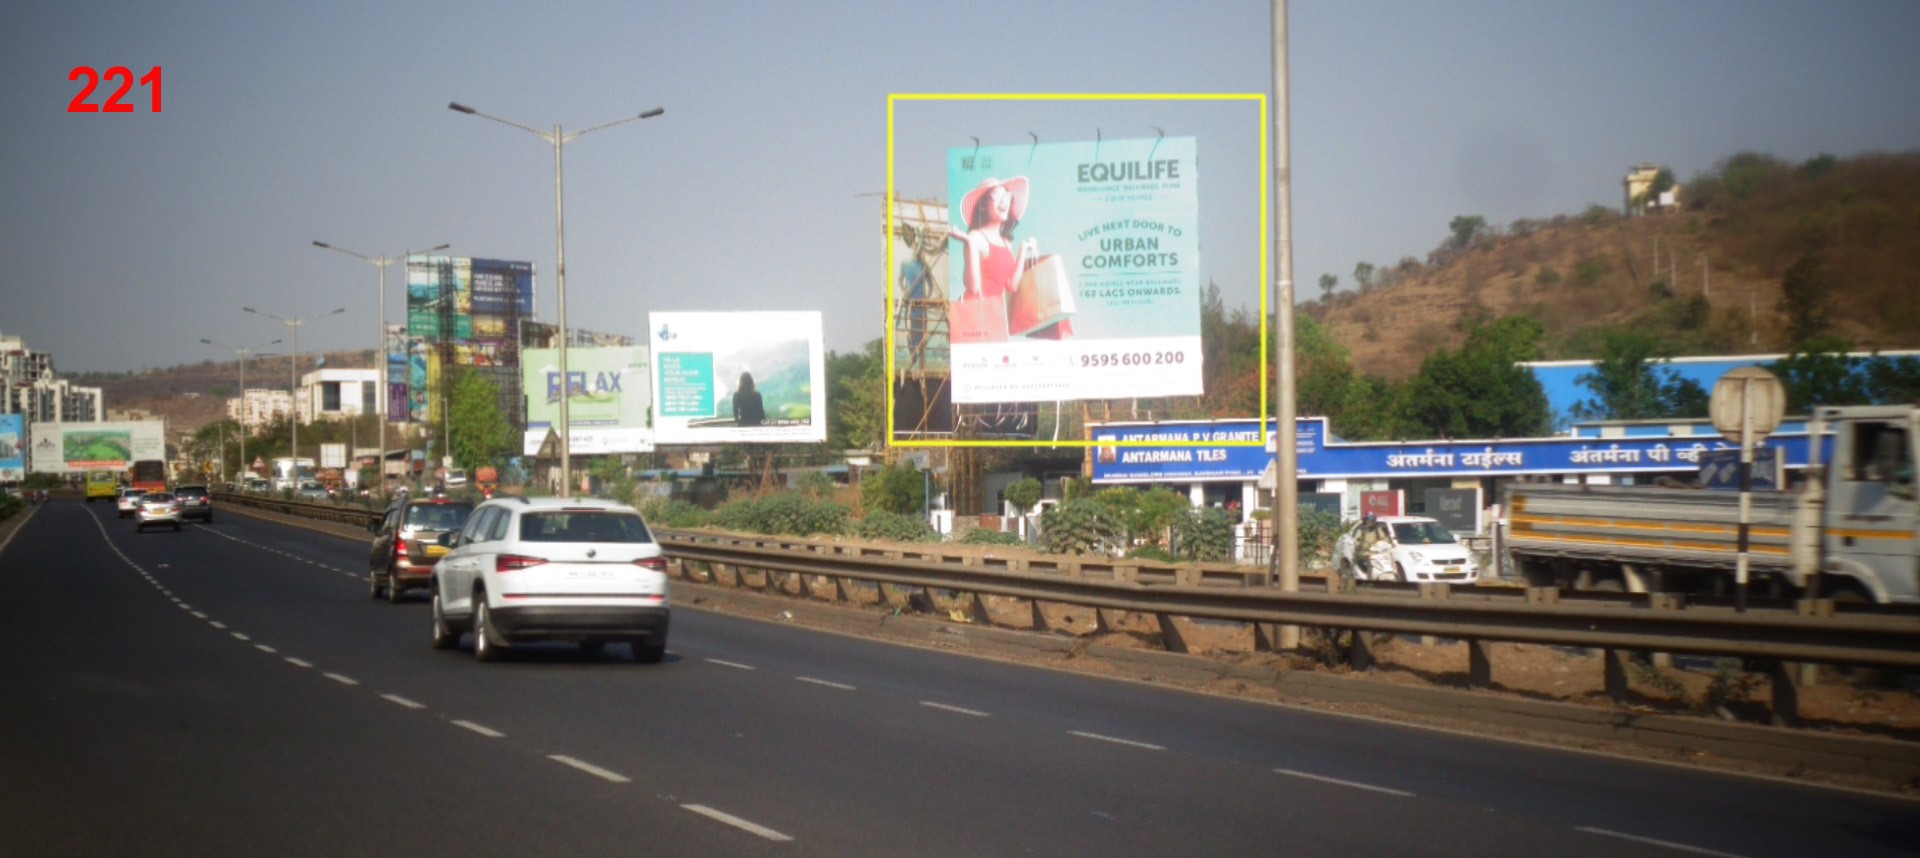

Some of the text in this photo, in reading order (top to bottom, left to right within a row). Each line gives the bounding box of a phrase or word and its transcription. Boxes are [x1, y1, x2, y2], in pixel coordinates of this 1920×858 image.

[1077, 159, 1180, 183] EQUILIFE
[1078, 219, 1183, 242] LIVE NEXT DOOR TO
[1100, 237, 1159, 252] URBAN
[1081, 252, 1179, 269] COMFORTS
[1099, 288, 1125, 298] LACS
[1080, 350, 1185, 367] 9595 600 200
[1122, 433, 1189, 447] ANTARMANA
[1212, 431, 1260, 445] GRANITE
[1122, 449, 1227, 463] ANTARMANA TILES
[1460, 446, 1523, 469] टाईल्स
[1568, 444, 1640, 464] अंतर्मना
[1645, 443, 1670, 463] पी
